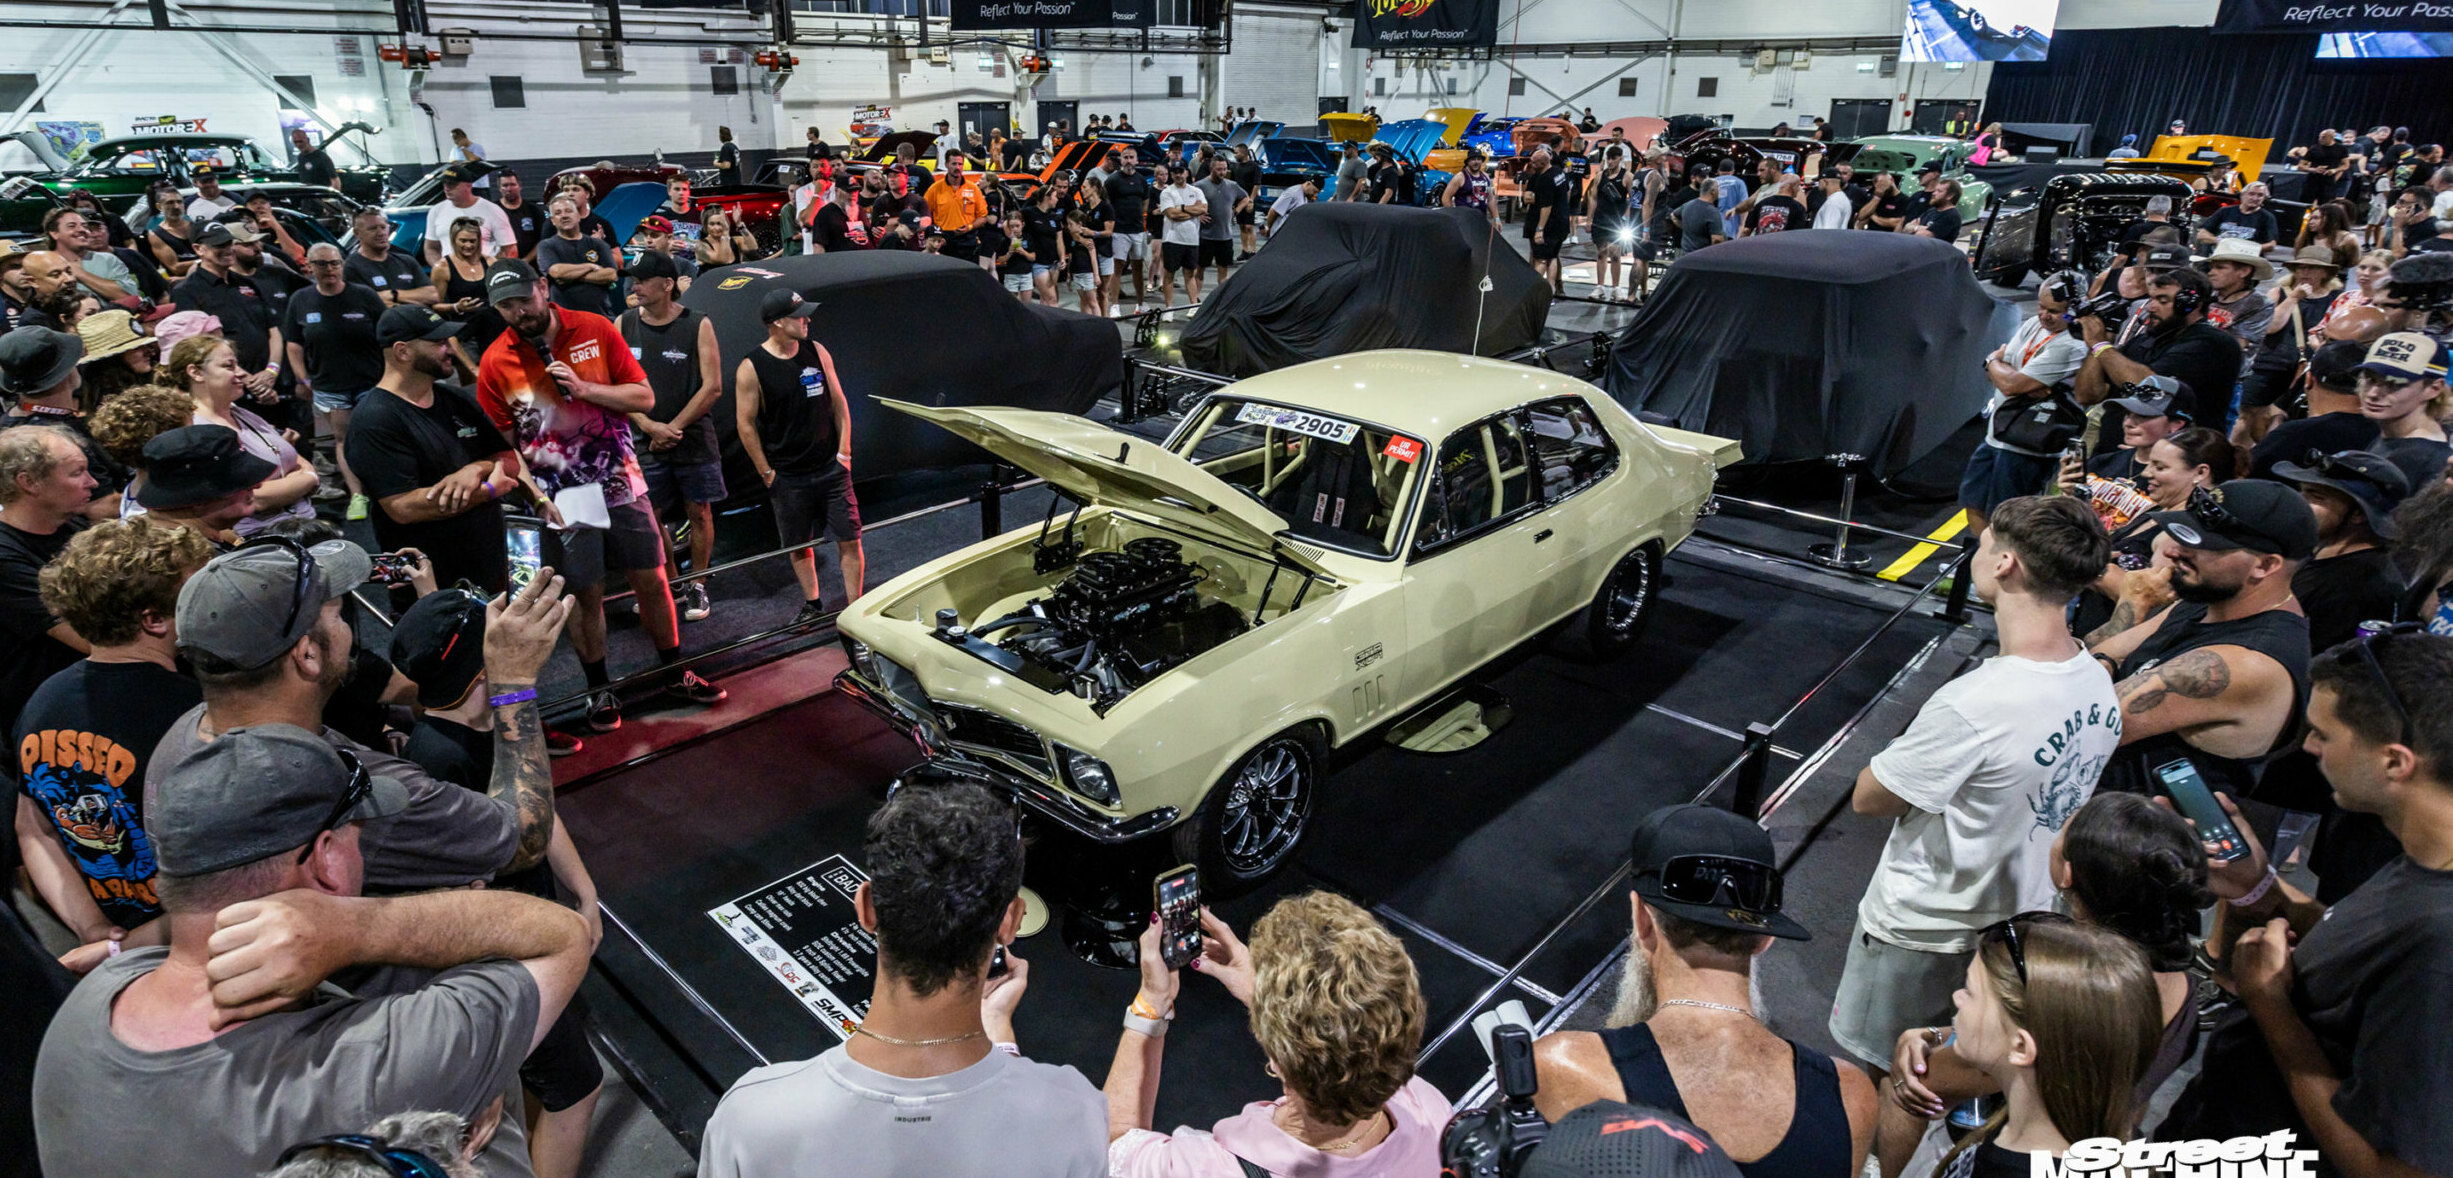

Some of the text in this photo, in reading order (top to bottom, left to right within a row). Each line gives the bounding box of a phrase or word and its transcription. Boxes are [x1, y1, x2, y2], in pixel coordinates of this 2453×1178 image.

[980, 5, 1010, 20] Reflect
[1014, 2, 1031, 15] Your
[2283, 5, 2356, 23] Reflect
[2363, 3, 2408, 18] Your
[1380, 30, 1408, 42] Reflect
[1411, 29, 1429, 38] Your
[569, 344, 600, 364] CREW
[1294, 415, 1346, 439] 2905
[1388, 445, 1415, 459] PERMIT
[1399, 440, 1411, 449] UR
[2034, 710, 2083, 767] CRAB
[2087, 703, 2100, 725] &
[20, 729, 136, 788] PISSED
[830, 931, 856, 953] Driveline
[815, 998, 846, 1025] SMP
